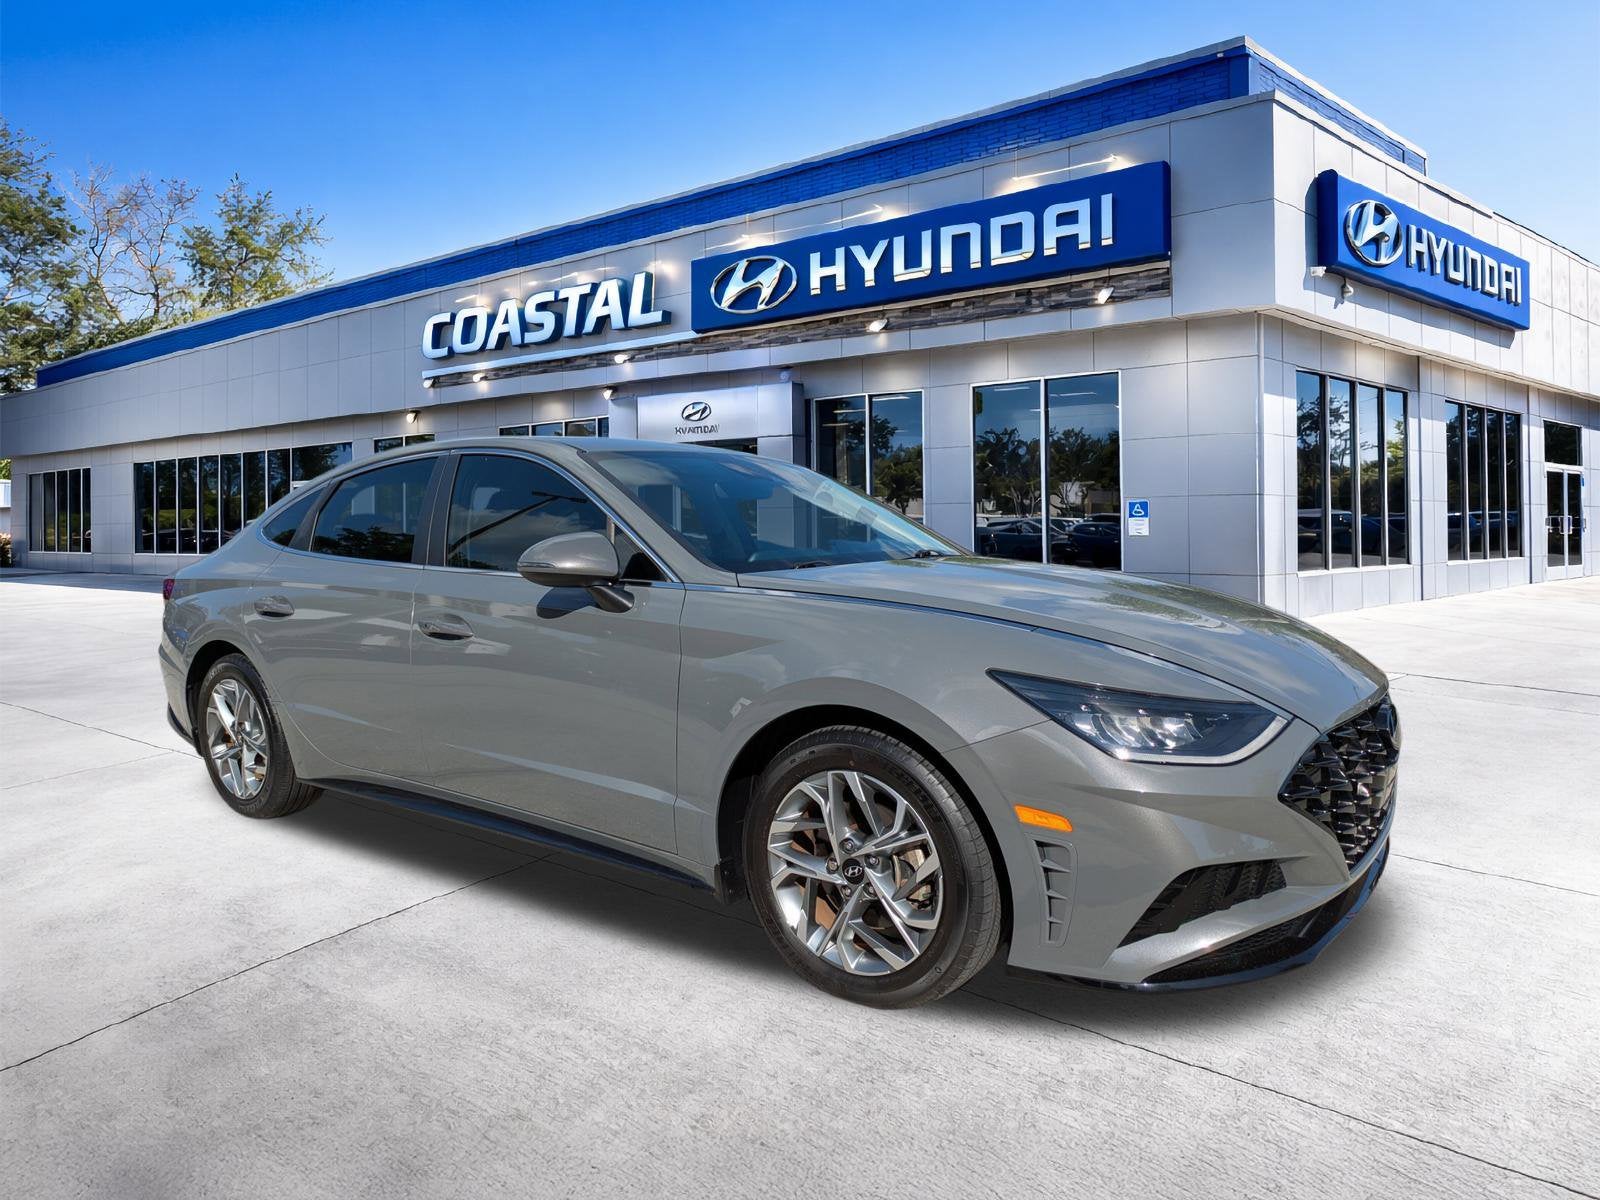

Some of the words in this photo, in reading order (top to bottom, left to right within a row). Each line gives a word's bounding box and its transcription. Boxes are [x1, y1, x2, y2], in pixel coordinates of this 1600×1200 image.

[809, 192, 1113, 296] HYUNDAI
[1405, 224, 1523, 306] HYUNDAI
[421, 271, 669, 359] COASTAL
